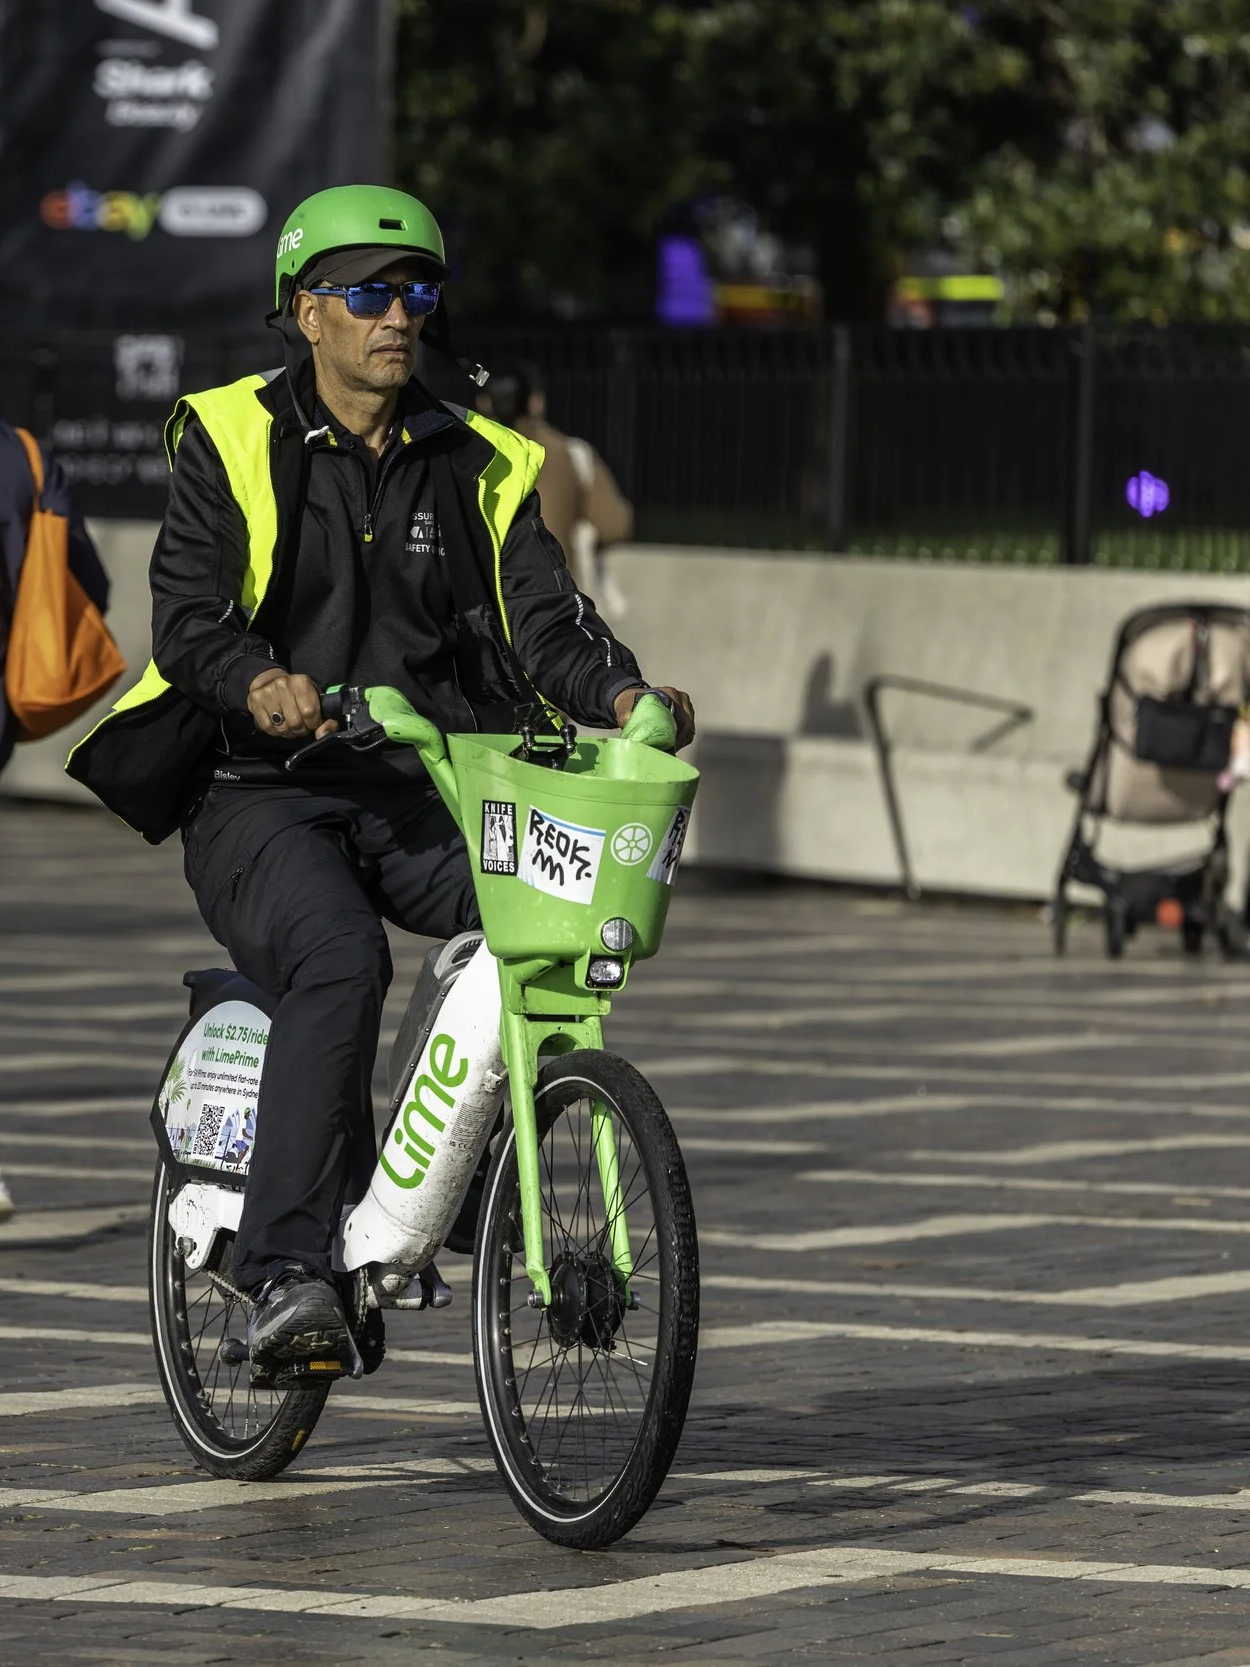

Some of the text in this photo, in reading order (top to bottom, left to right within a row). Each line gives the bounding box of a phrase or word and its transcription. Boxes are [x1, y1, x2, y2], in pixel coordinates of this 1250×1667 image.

[413, 512, 435, 521] SSUR
[405, 543, 431, 553] SAFETY
[484, 802, 513, 815] KNIFE
[483, 860, 515, 873] VOICES
[204, 1022, 270, 1046] Unlock $2.75/ride
[201, 1045, 259, 1068] with LimePrime
[218, 1072, 237, 1083] unlimited
[237, 1073, 259, 1086] flat-rate
[214, 1085, 237, 1095] anywhere
[242, 1087, 259, 1099] Sydne
[380, 1033, 469, 1190] Lime
